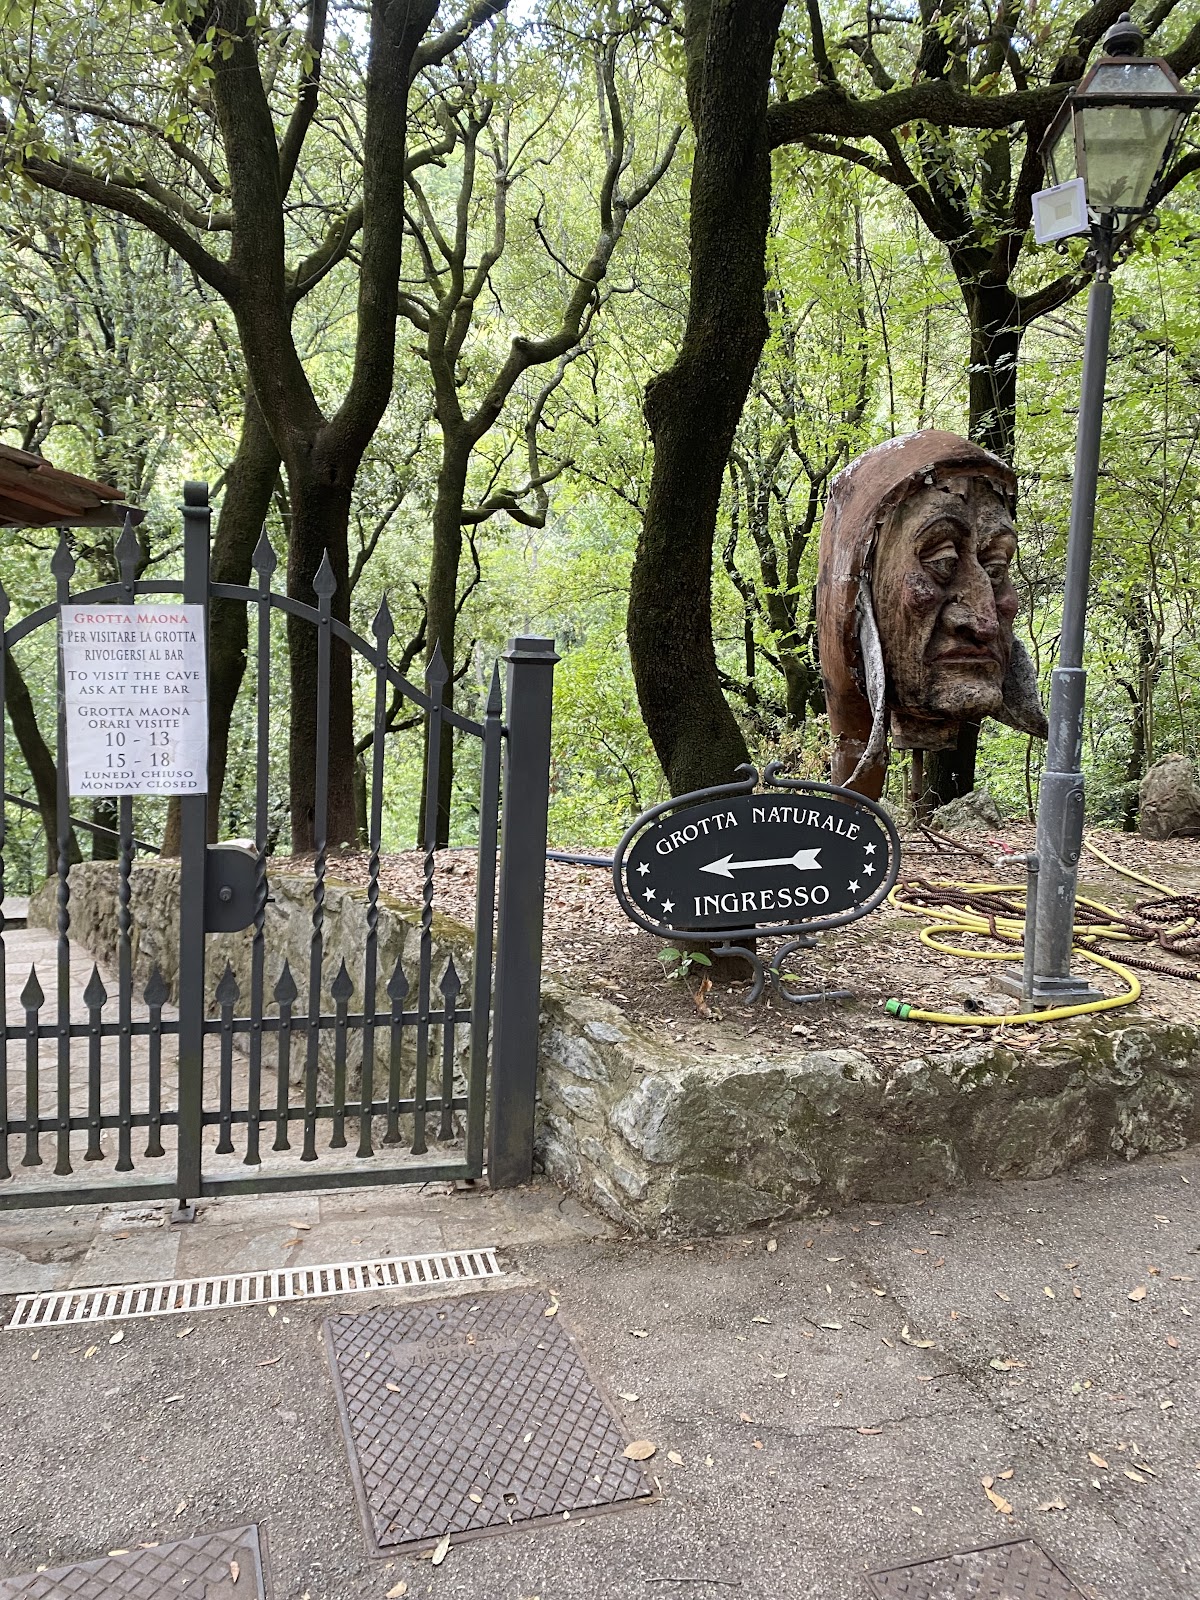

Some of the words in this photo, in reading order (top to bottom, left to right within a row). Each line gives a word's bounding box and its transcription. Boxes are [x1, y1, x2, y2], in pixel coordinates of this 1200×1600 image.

[74, 614, 132, 623] GROTTA
[137, 614, 188, 623] MAONA
[68, 630, 86, 642] PER
[90, 631, 136, 642] VISITARE
[141, 631, 151, 642] LA
[155, 631, 196, 642] GROTTA
[85, 650, 146, 660] RIVOLGERSI
[150, 650, 161, 660] AL
[165, 650, 184, 660] BAR
[68, 671, 87, 680] TO
[93, 672, 128, 680] VISIT
[134, 672, 160, 680] THE
[166, 672, 199, 680] CAVE
[79, 686, 104, 694] ASK
[109, 686, 125, 694] AT
[131, 686, 157, 694] THE
[78, 707, 133, 716] GROTTA
[139, 707, 190, 716] MAONA
[89, 720, 130, 728] ORARI
[136, 720, 179, 728] VISITE
[106, 732, 125, 746] 10
[150, 732, 169, 746] 13
[106, 754, 125, 767] 15
[151, 753, 169, 766] 18
[85, 770, 135, 779] LUNEDÌ
[656, 811, 738, 855] GROTTA
[753, 807, 860, 840] NATURALE
[694, 885, 829, 916] INGRESSO
